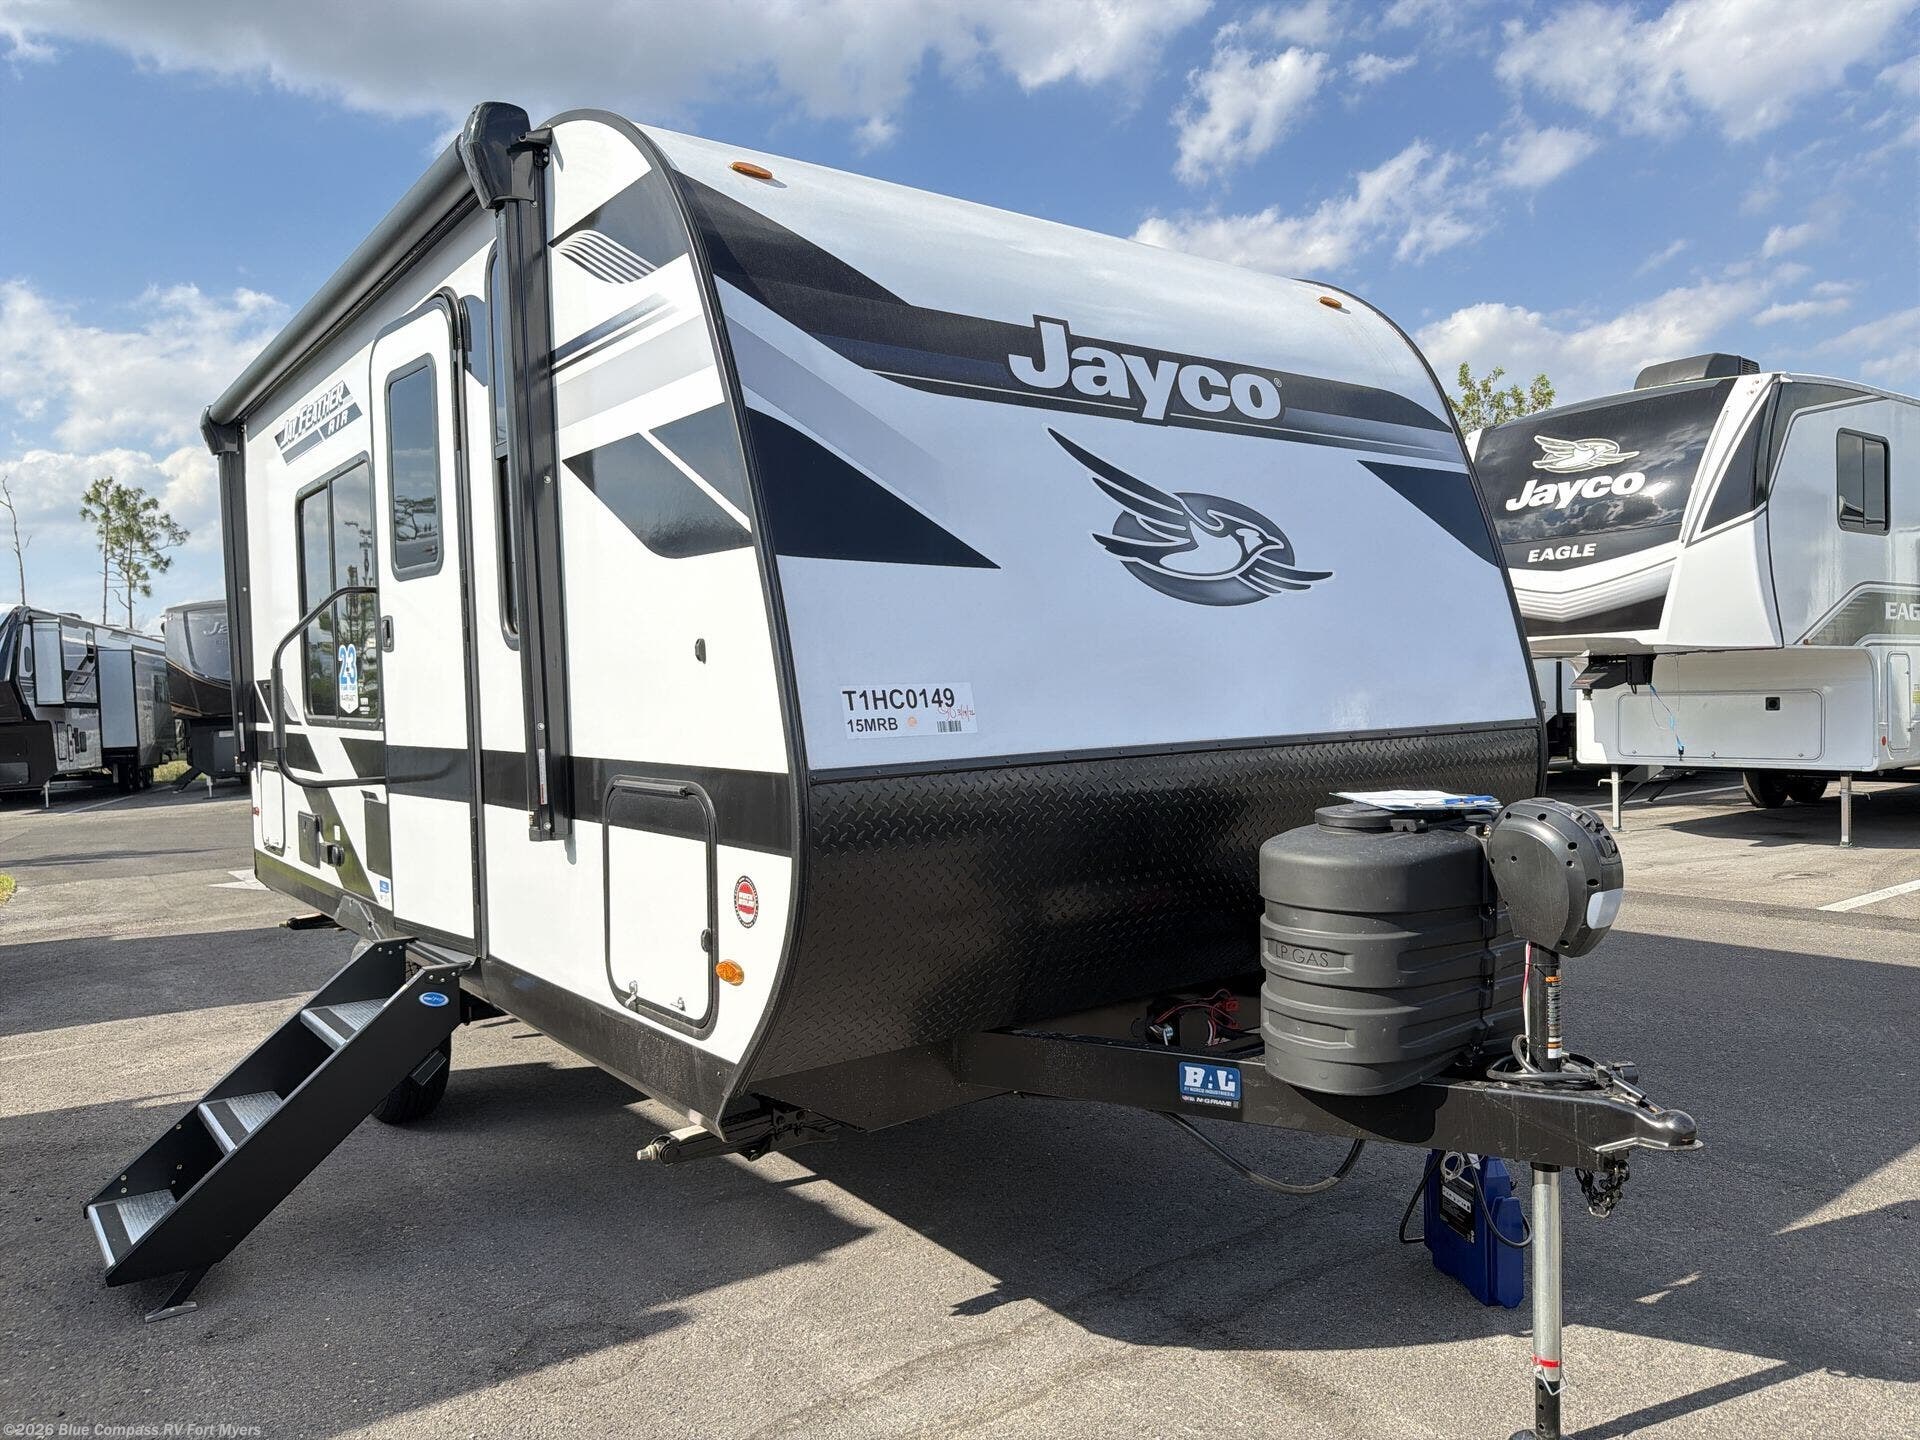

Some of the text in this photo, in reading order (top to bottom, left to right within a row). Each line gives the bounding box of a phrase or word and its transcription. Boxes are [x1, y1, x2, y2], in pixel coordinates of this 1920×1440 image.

[298, 381, 346, 437] FEATHER
[328, 409, 349, 435] AIR
[1505, 471, 1646, 511] Jayco
[1527, 543, 1597, 563] EAGLE
[842, 688, 955, 711] T1HC0149
[847, 717, 899, 733] 15MRB
[1275, 943, 1329, 968] LP GAS
[1184, 1066, 1236, 1092] BAL
